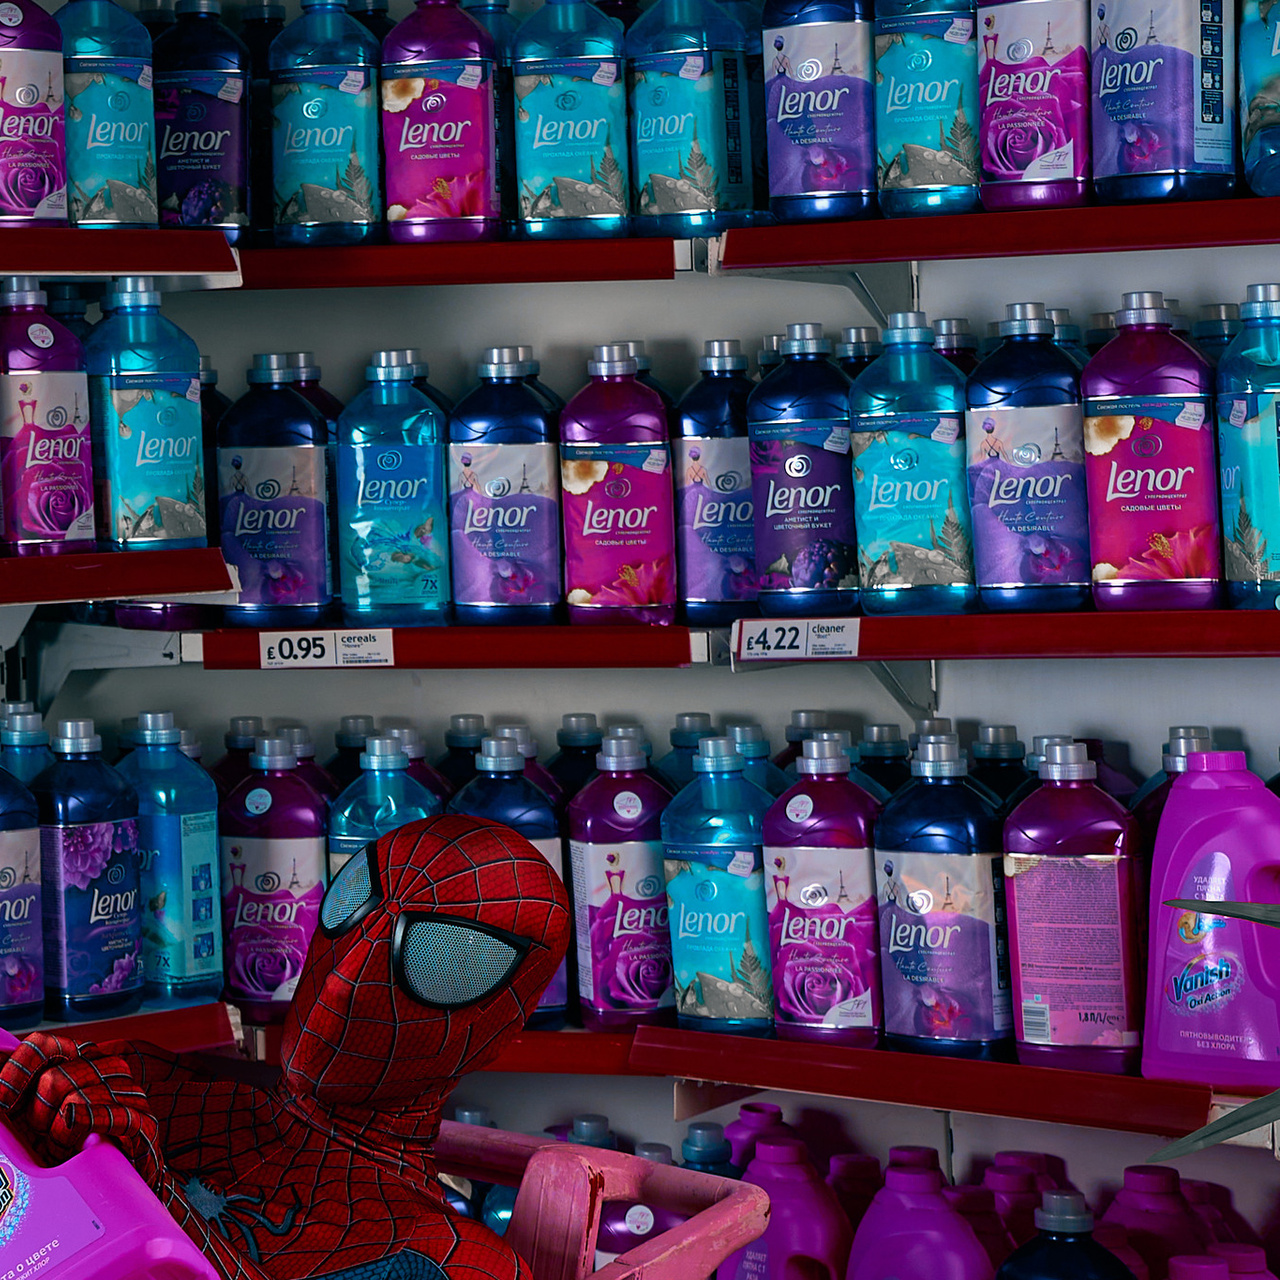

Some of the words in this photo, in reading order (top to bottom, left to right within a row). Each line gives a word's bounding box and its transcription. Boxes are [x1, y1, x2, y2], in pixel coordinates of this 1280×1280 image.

[886, 76, 959, 113] Lenor
[986, 67, 1061, 105] Lenor
[1099, 58, 1163, 98] Lenor
[777, 85, 849, 123] Lenor
[86, 114, 148, 148] Lenor
[159, 125, 231, 160] Lenor
[284, 123, 352, 154] Lenor
[399, 118, 471, 150] Lenor
[533, 114, 606, 148] Lenor
[637, 112, 693, 144] Lenor
[25, 431, 84, 467] Lenor
[136, 431, 196, 467] Lenor
[358, 472, 427, 508] Lenor
[766, 480, 840, 518] Lenor
[869, 475, 947, 512] Lenor
[988, 470, 1072, 508] Lenor
[1106, 461, 1194, 502] Lenor
[235, 502, 305, 536] Lenor
[464, 500, 536, 536] Lenor
[583, 501, 657, 536] Lenor
[693, 495, 754, 530] Leno
[341, 634, 376, 643] cereals
[747, 627, 799, 650] £4.22
[812, 624, 845, 633] cleaner
[267, 637, 325, 660] £0.95
[90, 888, 137, 925] Lenor
[233, 894, 305, 927] Lenor
[613, 901, 669, 937] Leno
[678, 902, 744, 938] Lenor
[780, 909, 855, 945] Lenor
[888, 914, 961, 955] Lenor
[1172, 954, 1230, 1001] Vanish
[16, 1263, 24, 1272] о
[25, 1239, 60, 1266] цвете
[33, 1257, 50, 1272] ХЛОР
